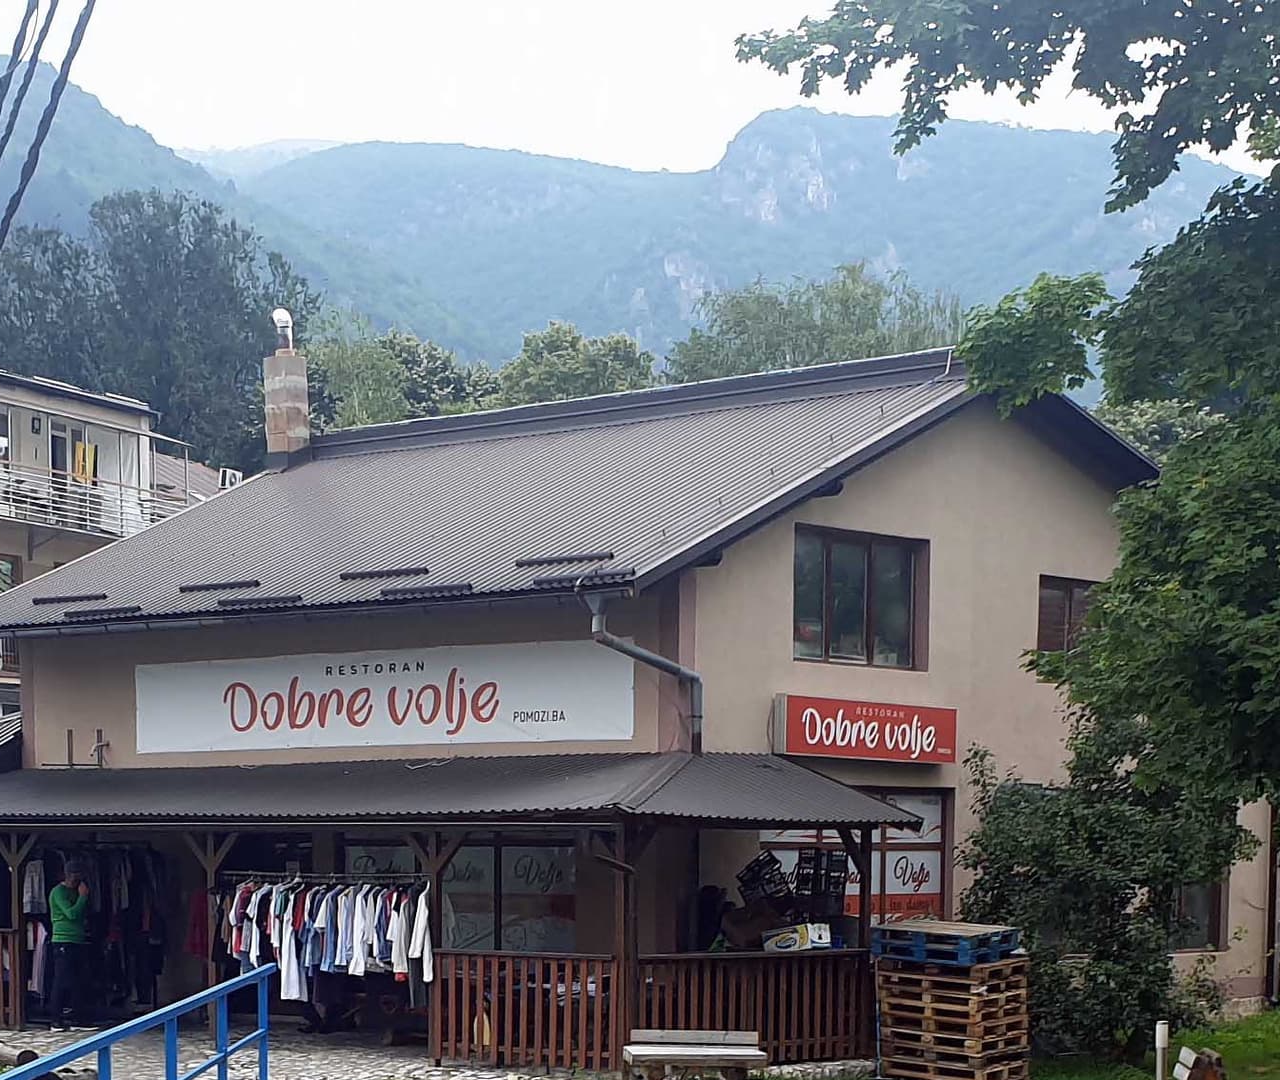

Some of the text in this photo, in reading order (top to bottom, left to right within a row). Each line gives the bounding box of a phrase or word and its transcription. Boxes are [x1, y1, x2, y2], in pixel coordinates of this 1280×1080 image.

[325, 661, 426, 676] RESTORAN
[223, 667, 500, 735] Dobre volje
[856, 706, 905, 719] RESTORAN
[512, 710, 567, 724] POMOZI.BA
[802, 707, 936, 759] Dobre volje
[893, 855, 931, 892] Volje
